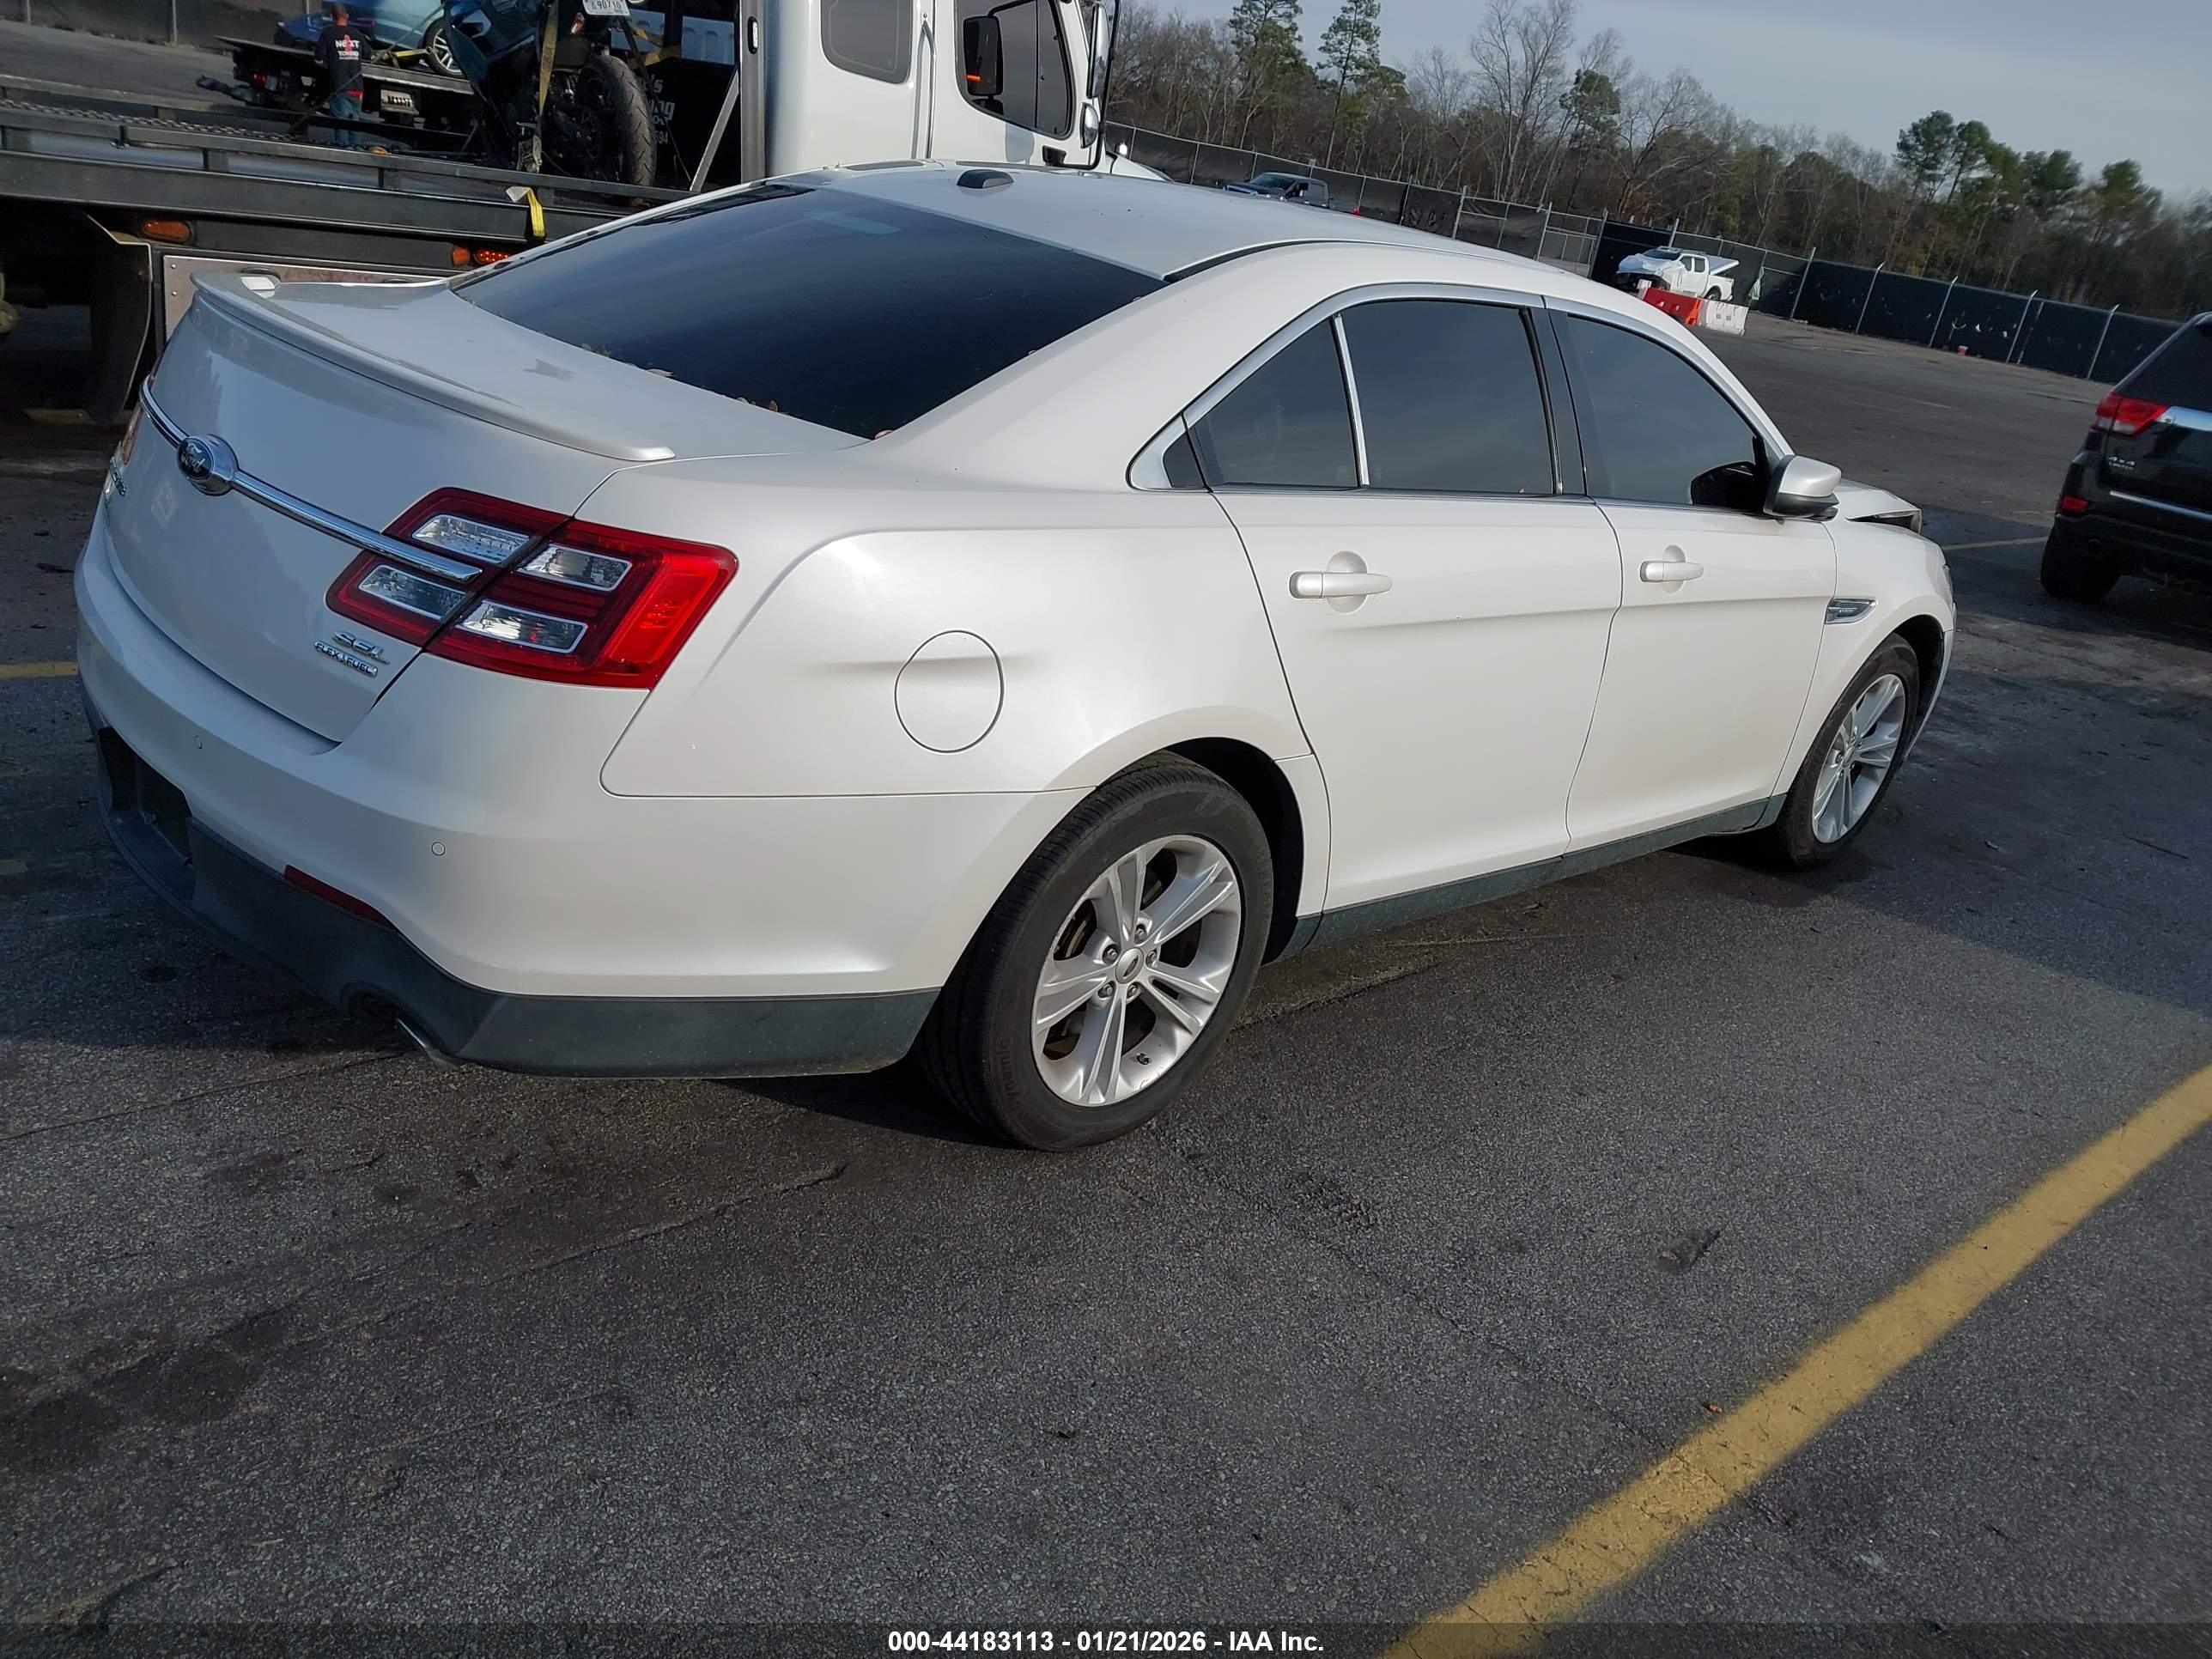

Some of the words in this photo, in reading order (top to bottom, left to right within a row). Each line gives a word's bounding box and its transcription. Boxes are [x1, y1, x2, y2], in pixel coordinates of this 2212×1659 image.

[335, 40, 360, 49] NEXT
[180, 442, 206, 473] Ford
[314, 642, 341, 660] FLEX
[345, 656, 374, 674] FUEL
[332, 631, 390, 665] SEL
